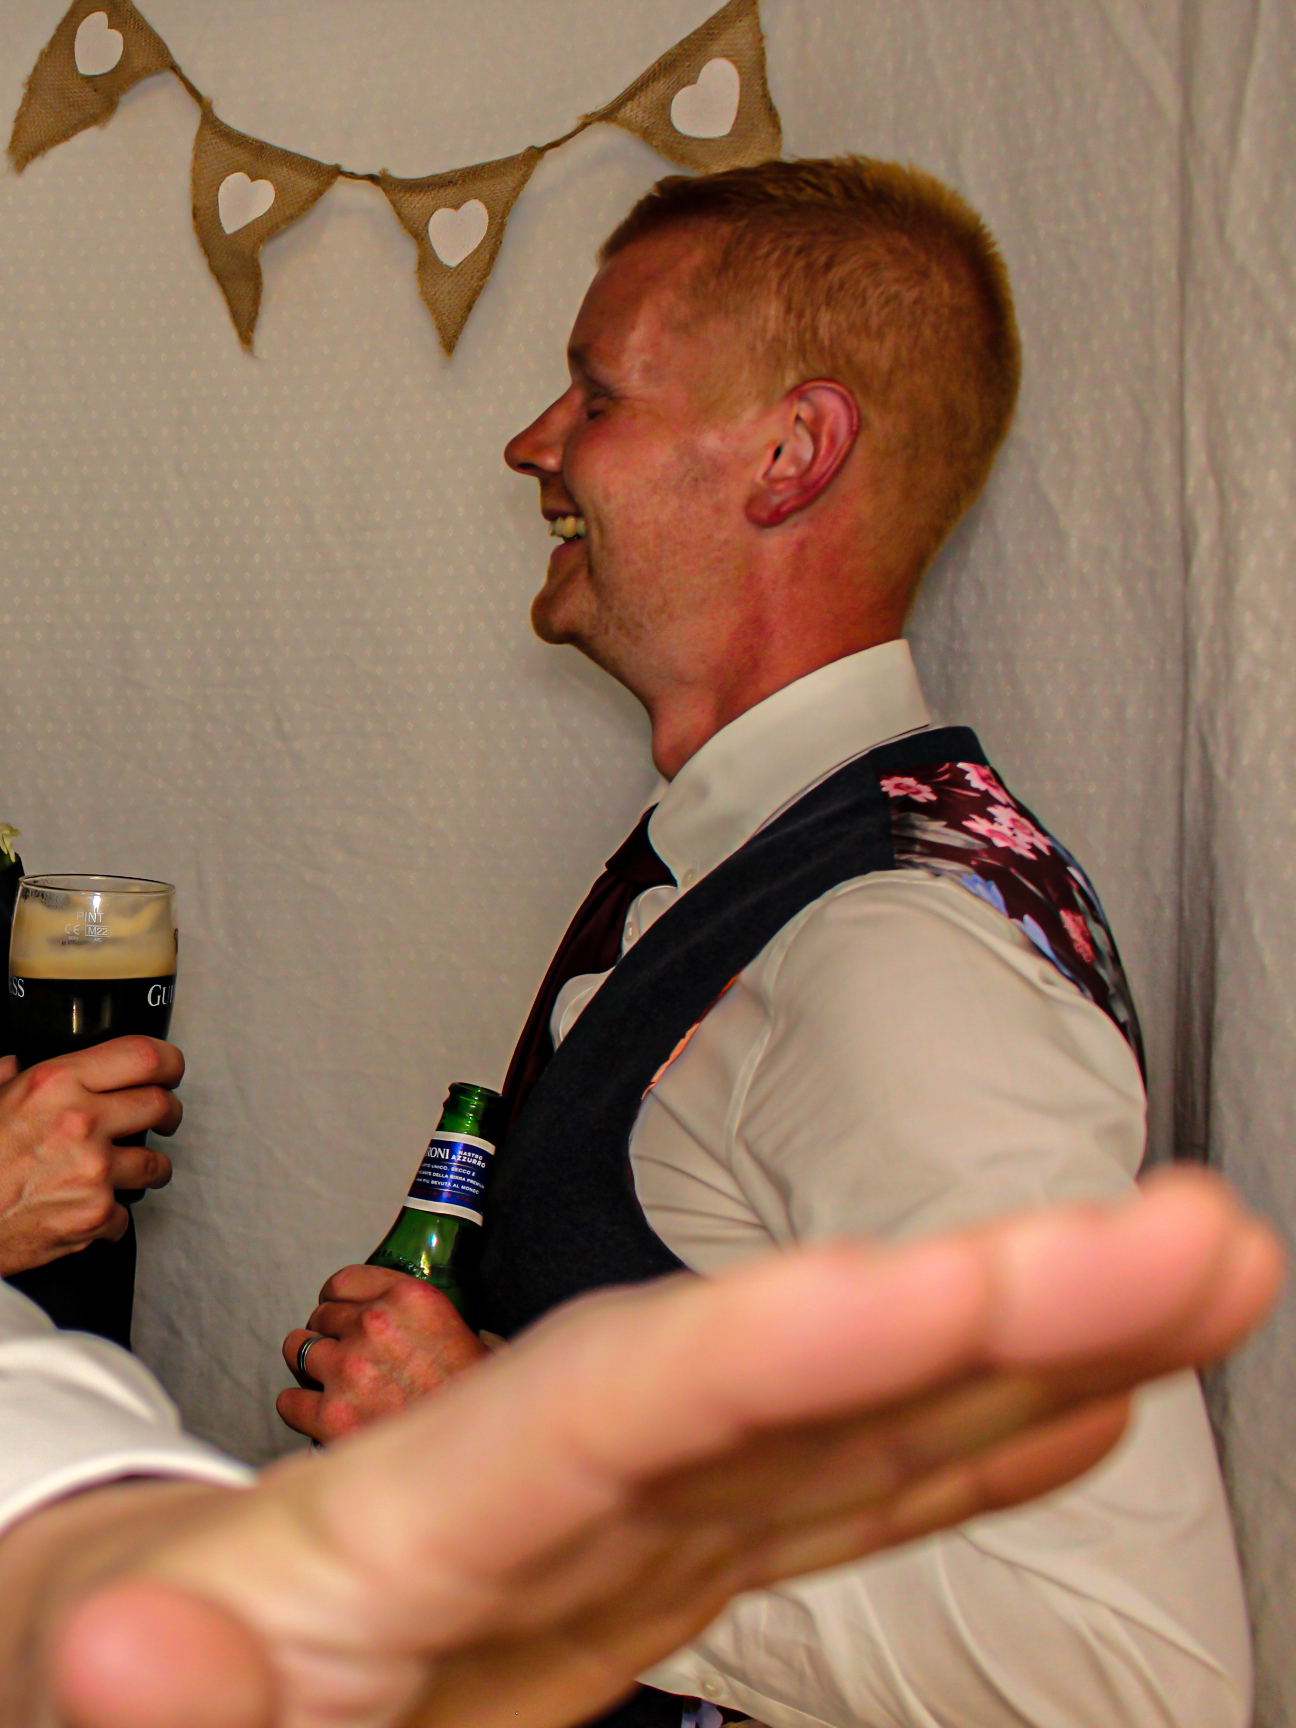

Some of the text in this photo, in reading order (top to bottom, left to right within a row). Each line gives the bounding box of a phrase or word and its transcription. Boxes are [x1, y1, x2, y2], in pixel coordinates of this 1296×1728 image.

[76, 911, 104, 923] PINT
[87, 926, 108, 936] M22
[451, 1155, 486, 1168] AZZURRO
[430, 1179, 451, 1187] BEVUTA
